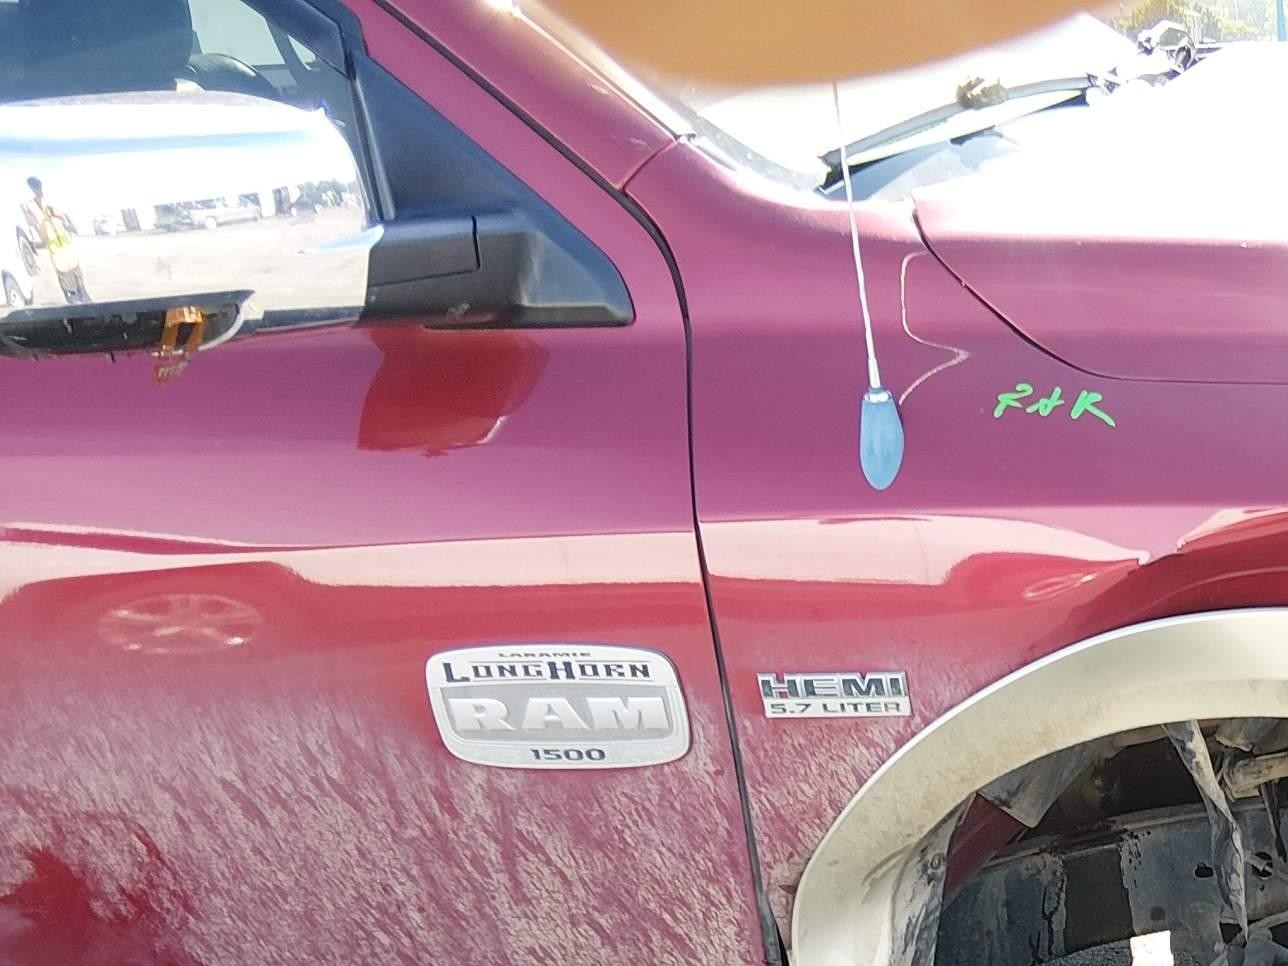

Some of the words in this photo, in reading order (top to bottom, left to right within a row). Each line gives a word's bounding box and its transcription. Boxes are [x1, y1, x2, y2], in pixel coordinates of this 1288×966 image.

[757, 672, 908, 699] HEMI
[449, 697, 670, 731] RAM
[770, 702, 812, 714] 5.7
[822, 702, 901, 713] LITER
[530, 748, 607, 761] 1500
